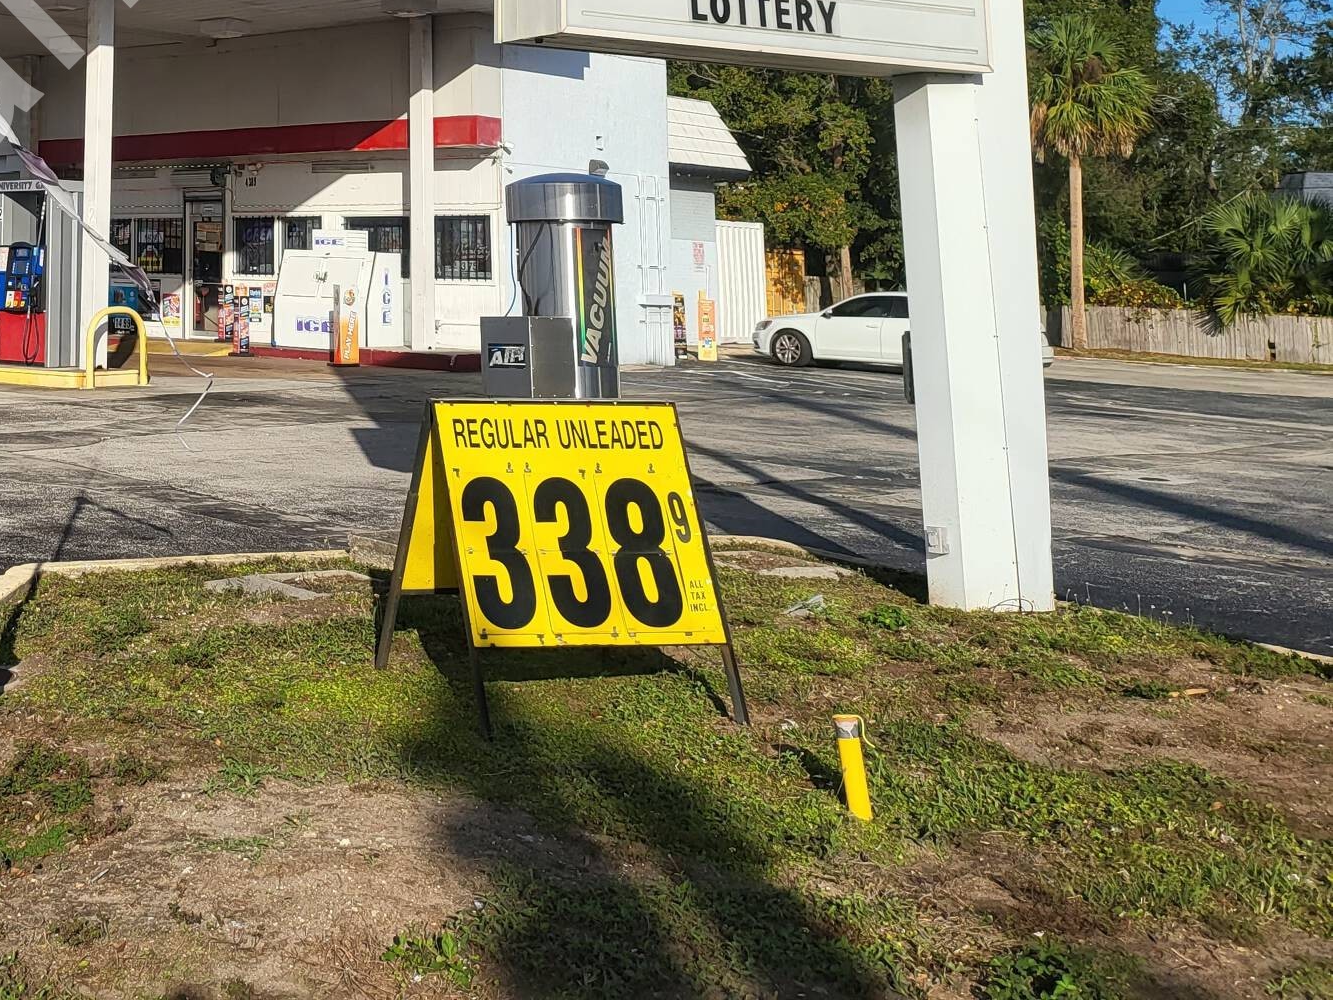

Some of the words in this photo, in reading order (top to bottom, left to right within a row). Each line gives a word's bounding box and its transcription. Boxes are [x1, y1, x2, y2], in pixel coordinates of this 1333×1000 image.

[314, 238, 345, 247] ICE
[581, 236, 612, 365] VACUUM
[489, 346, 526, 367] AIR
[452, 418, 550, 449] REGULAR
[556, 419, 664, 450] UNLEADED
[461, 476, 684, 630] 338
[689, 579, 704, 589] ALL
[690, 592, 707, 600] TAX
